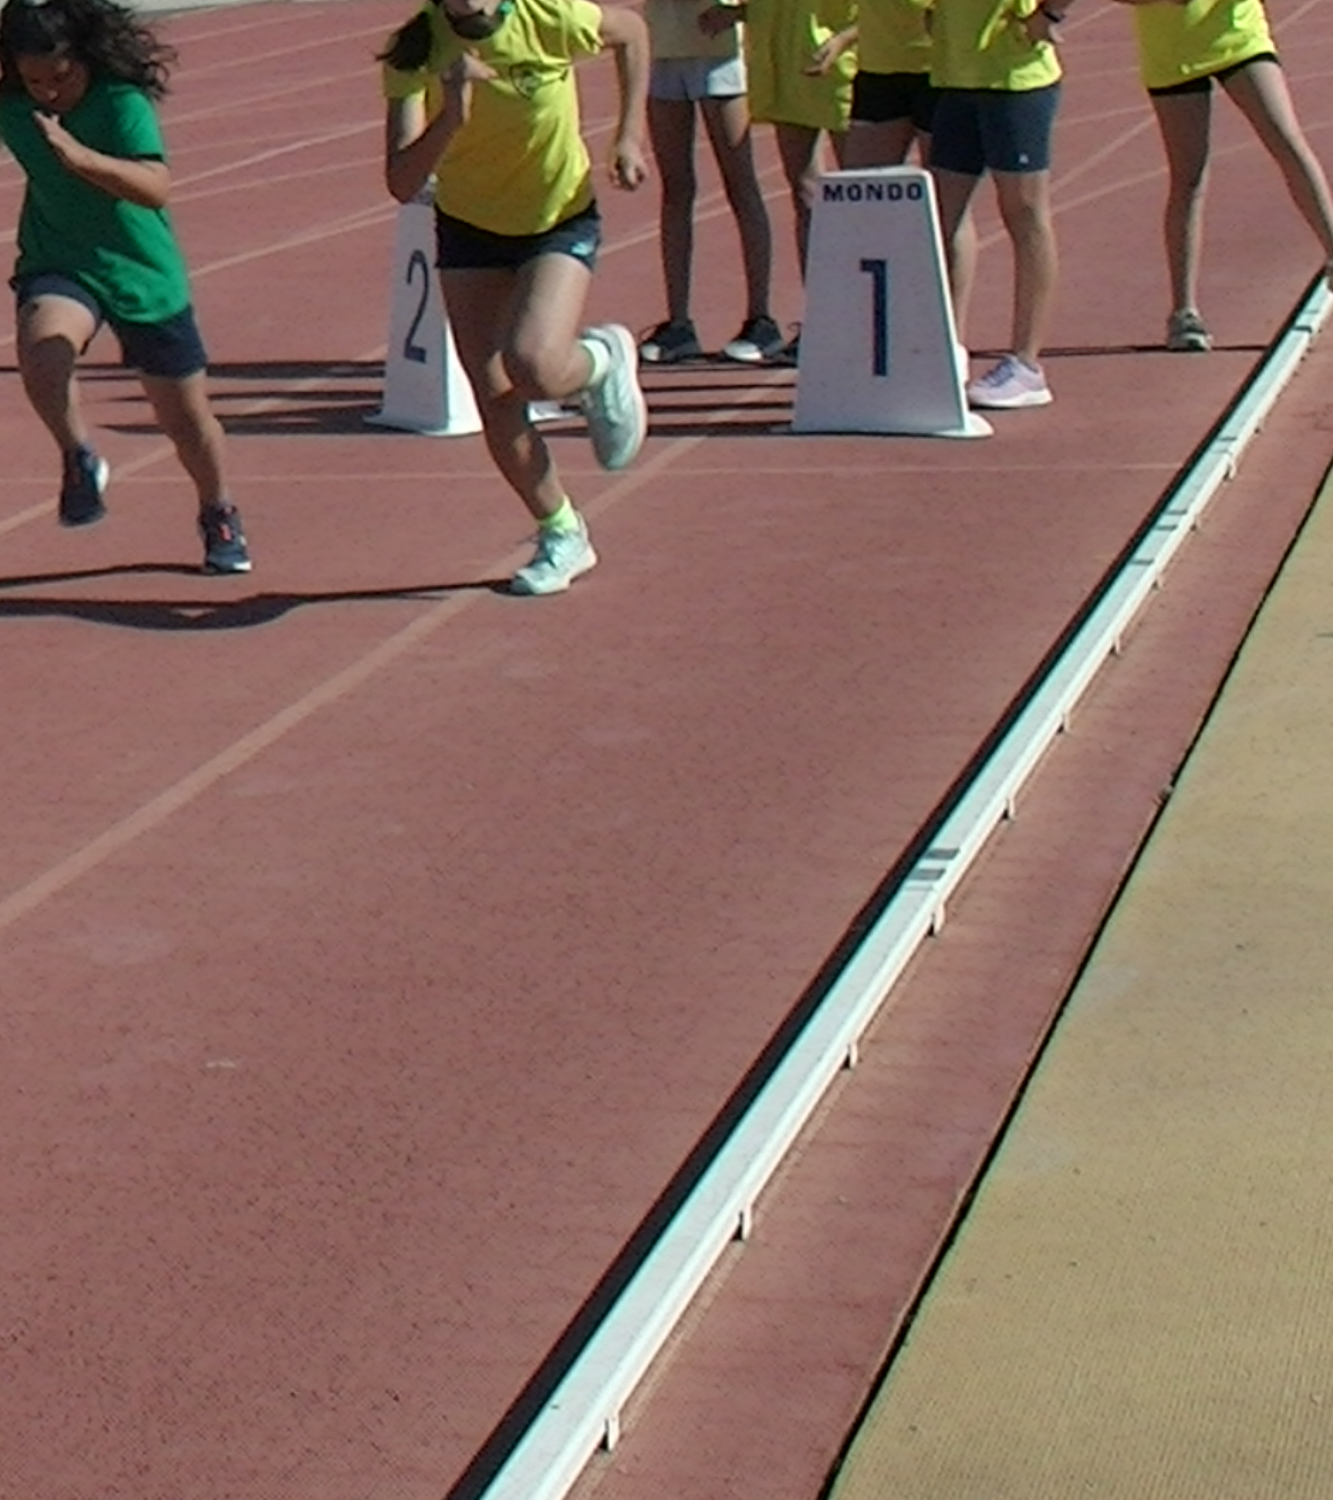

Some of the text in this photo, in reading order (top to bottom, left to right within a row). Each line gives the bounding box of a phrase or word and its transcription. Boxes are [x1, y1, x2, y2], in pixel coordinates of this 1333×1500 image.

[823, 182, 923, 202] MONDO
[404, 249, 429, 364] 2
[859, 258, 887, 377] 1
